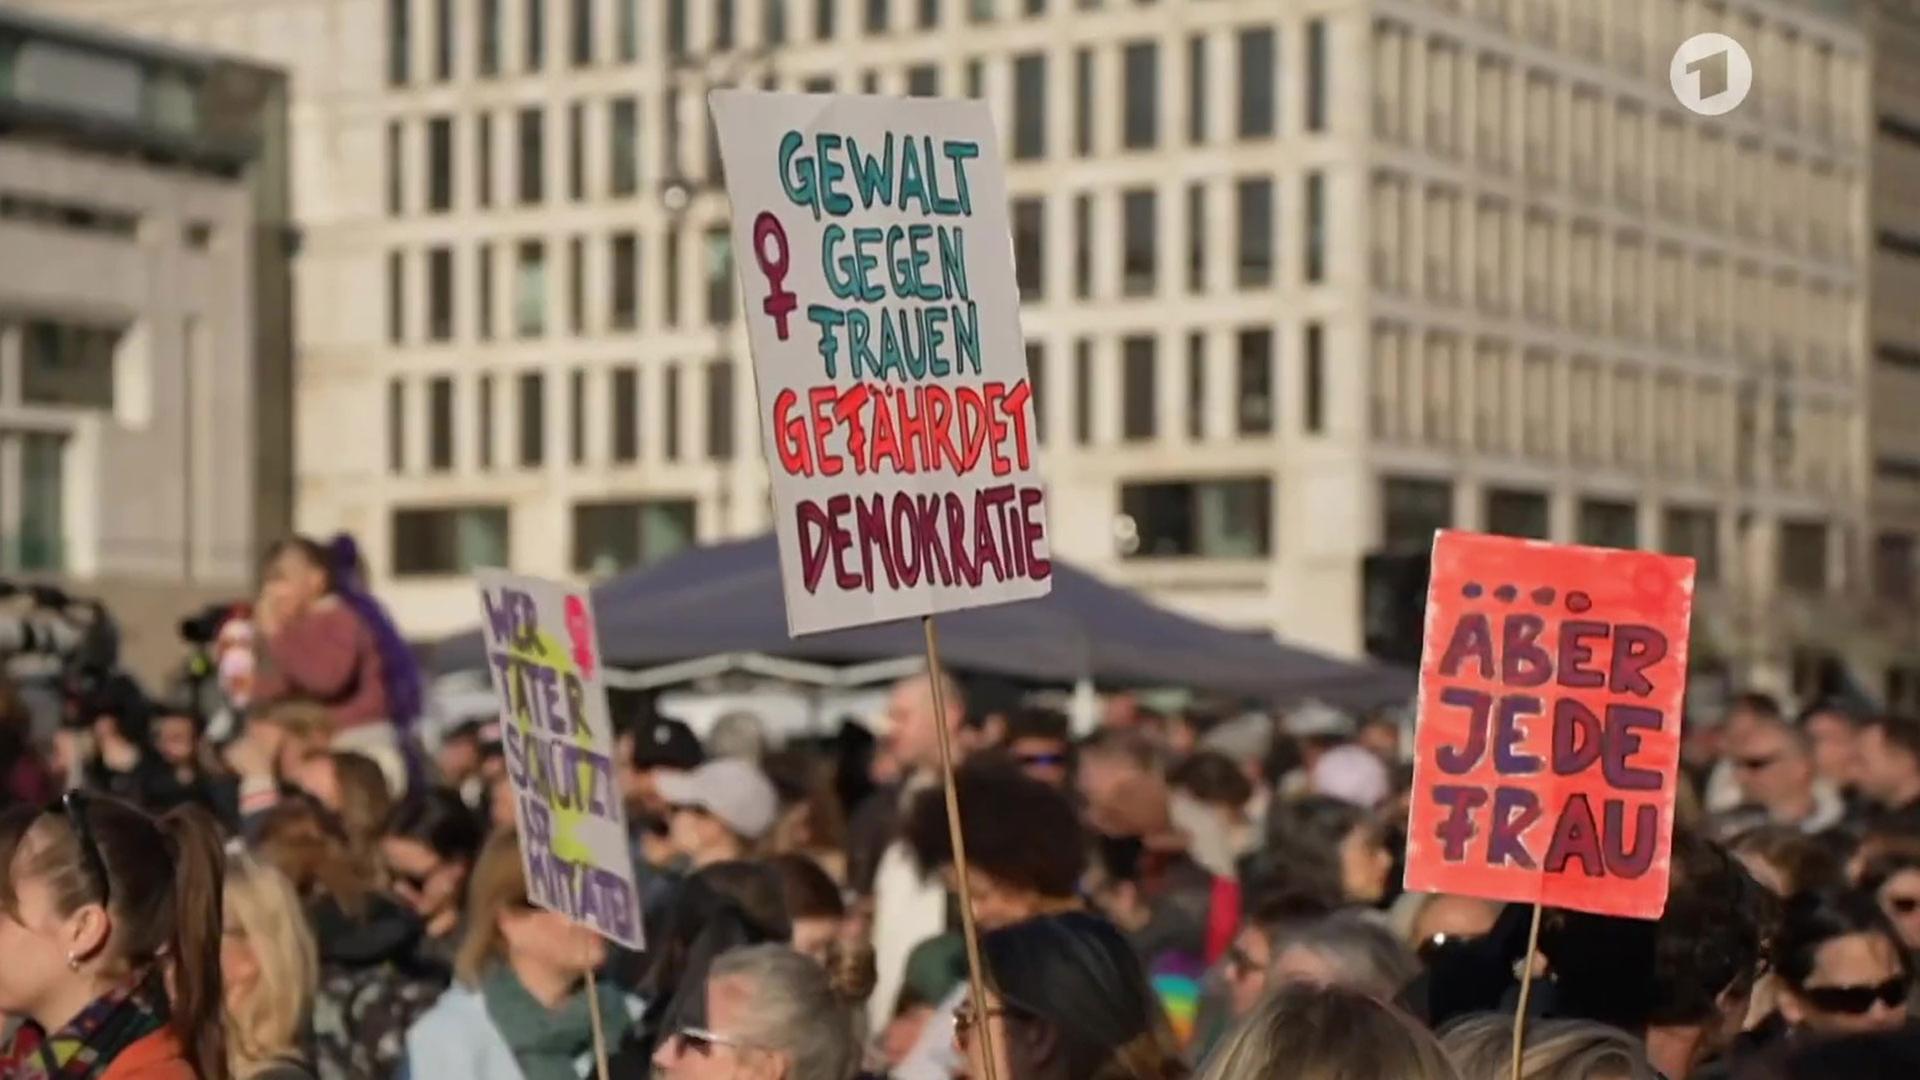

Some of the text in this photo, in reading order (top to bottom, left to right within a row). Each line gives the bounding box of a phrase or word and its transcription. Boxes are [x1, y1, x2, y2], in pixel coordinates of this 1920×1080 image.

[778, 130, 979, 220] GEWALT
[821, 223, 970, 303] GEGEN
[808, 302, 982, 381] FRAUEN
[772, 378, 1033, 477] GEFÄHRDET
[796, 484, 1051, 594] DEMOKRATIE
[483, 587, 548, 656] WER
[1438, 613, 1667, 697] ABER
[1435, 686, 1664, 791] JEDE
[1432, 784, 1659, 879] FRAU
